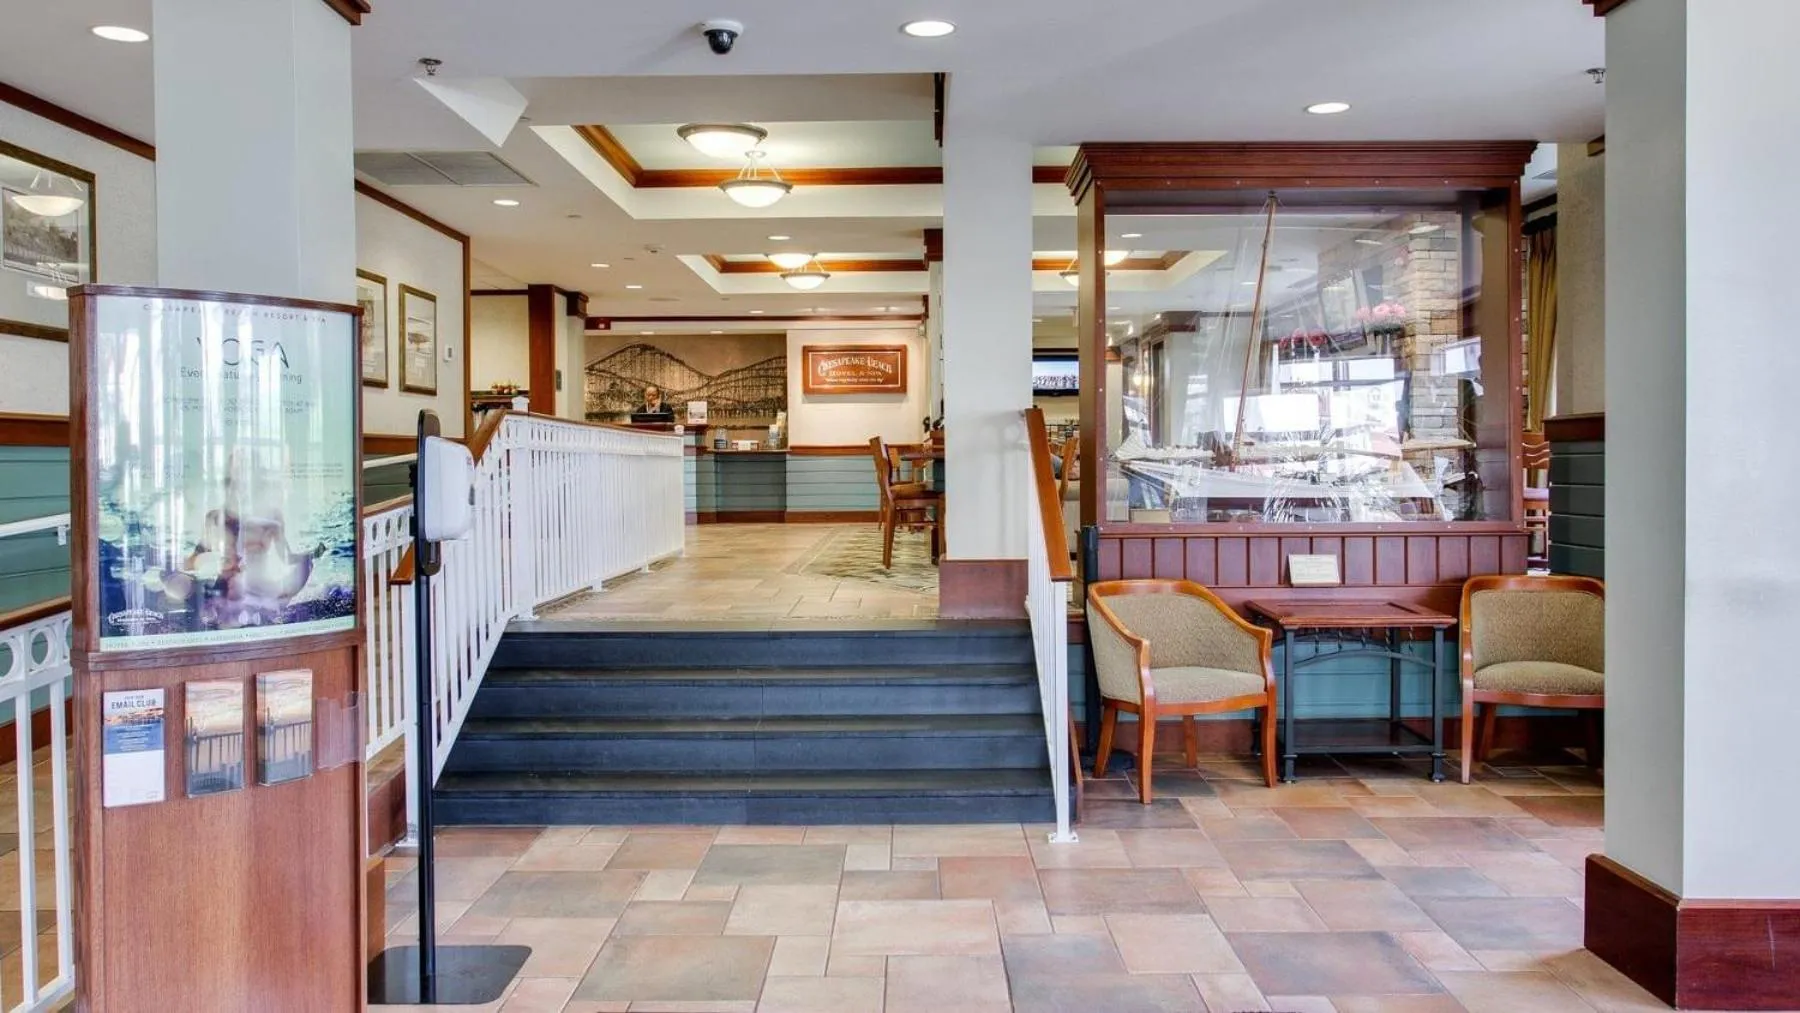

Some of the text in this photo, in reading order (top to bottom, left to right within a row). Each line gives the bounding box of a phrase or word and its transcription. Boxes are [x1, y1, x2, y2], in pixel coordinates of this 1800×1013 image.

[196, 337, 290, 369] OGA
[111, 697, 156, 710] EMAIL CLUB
